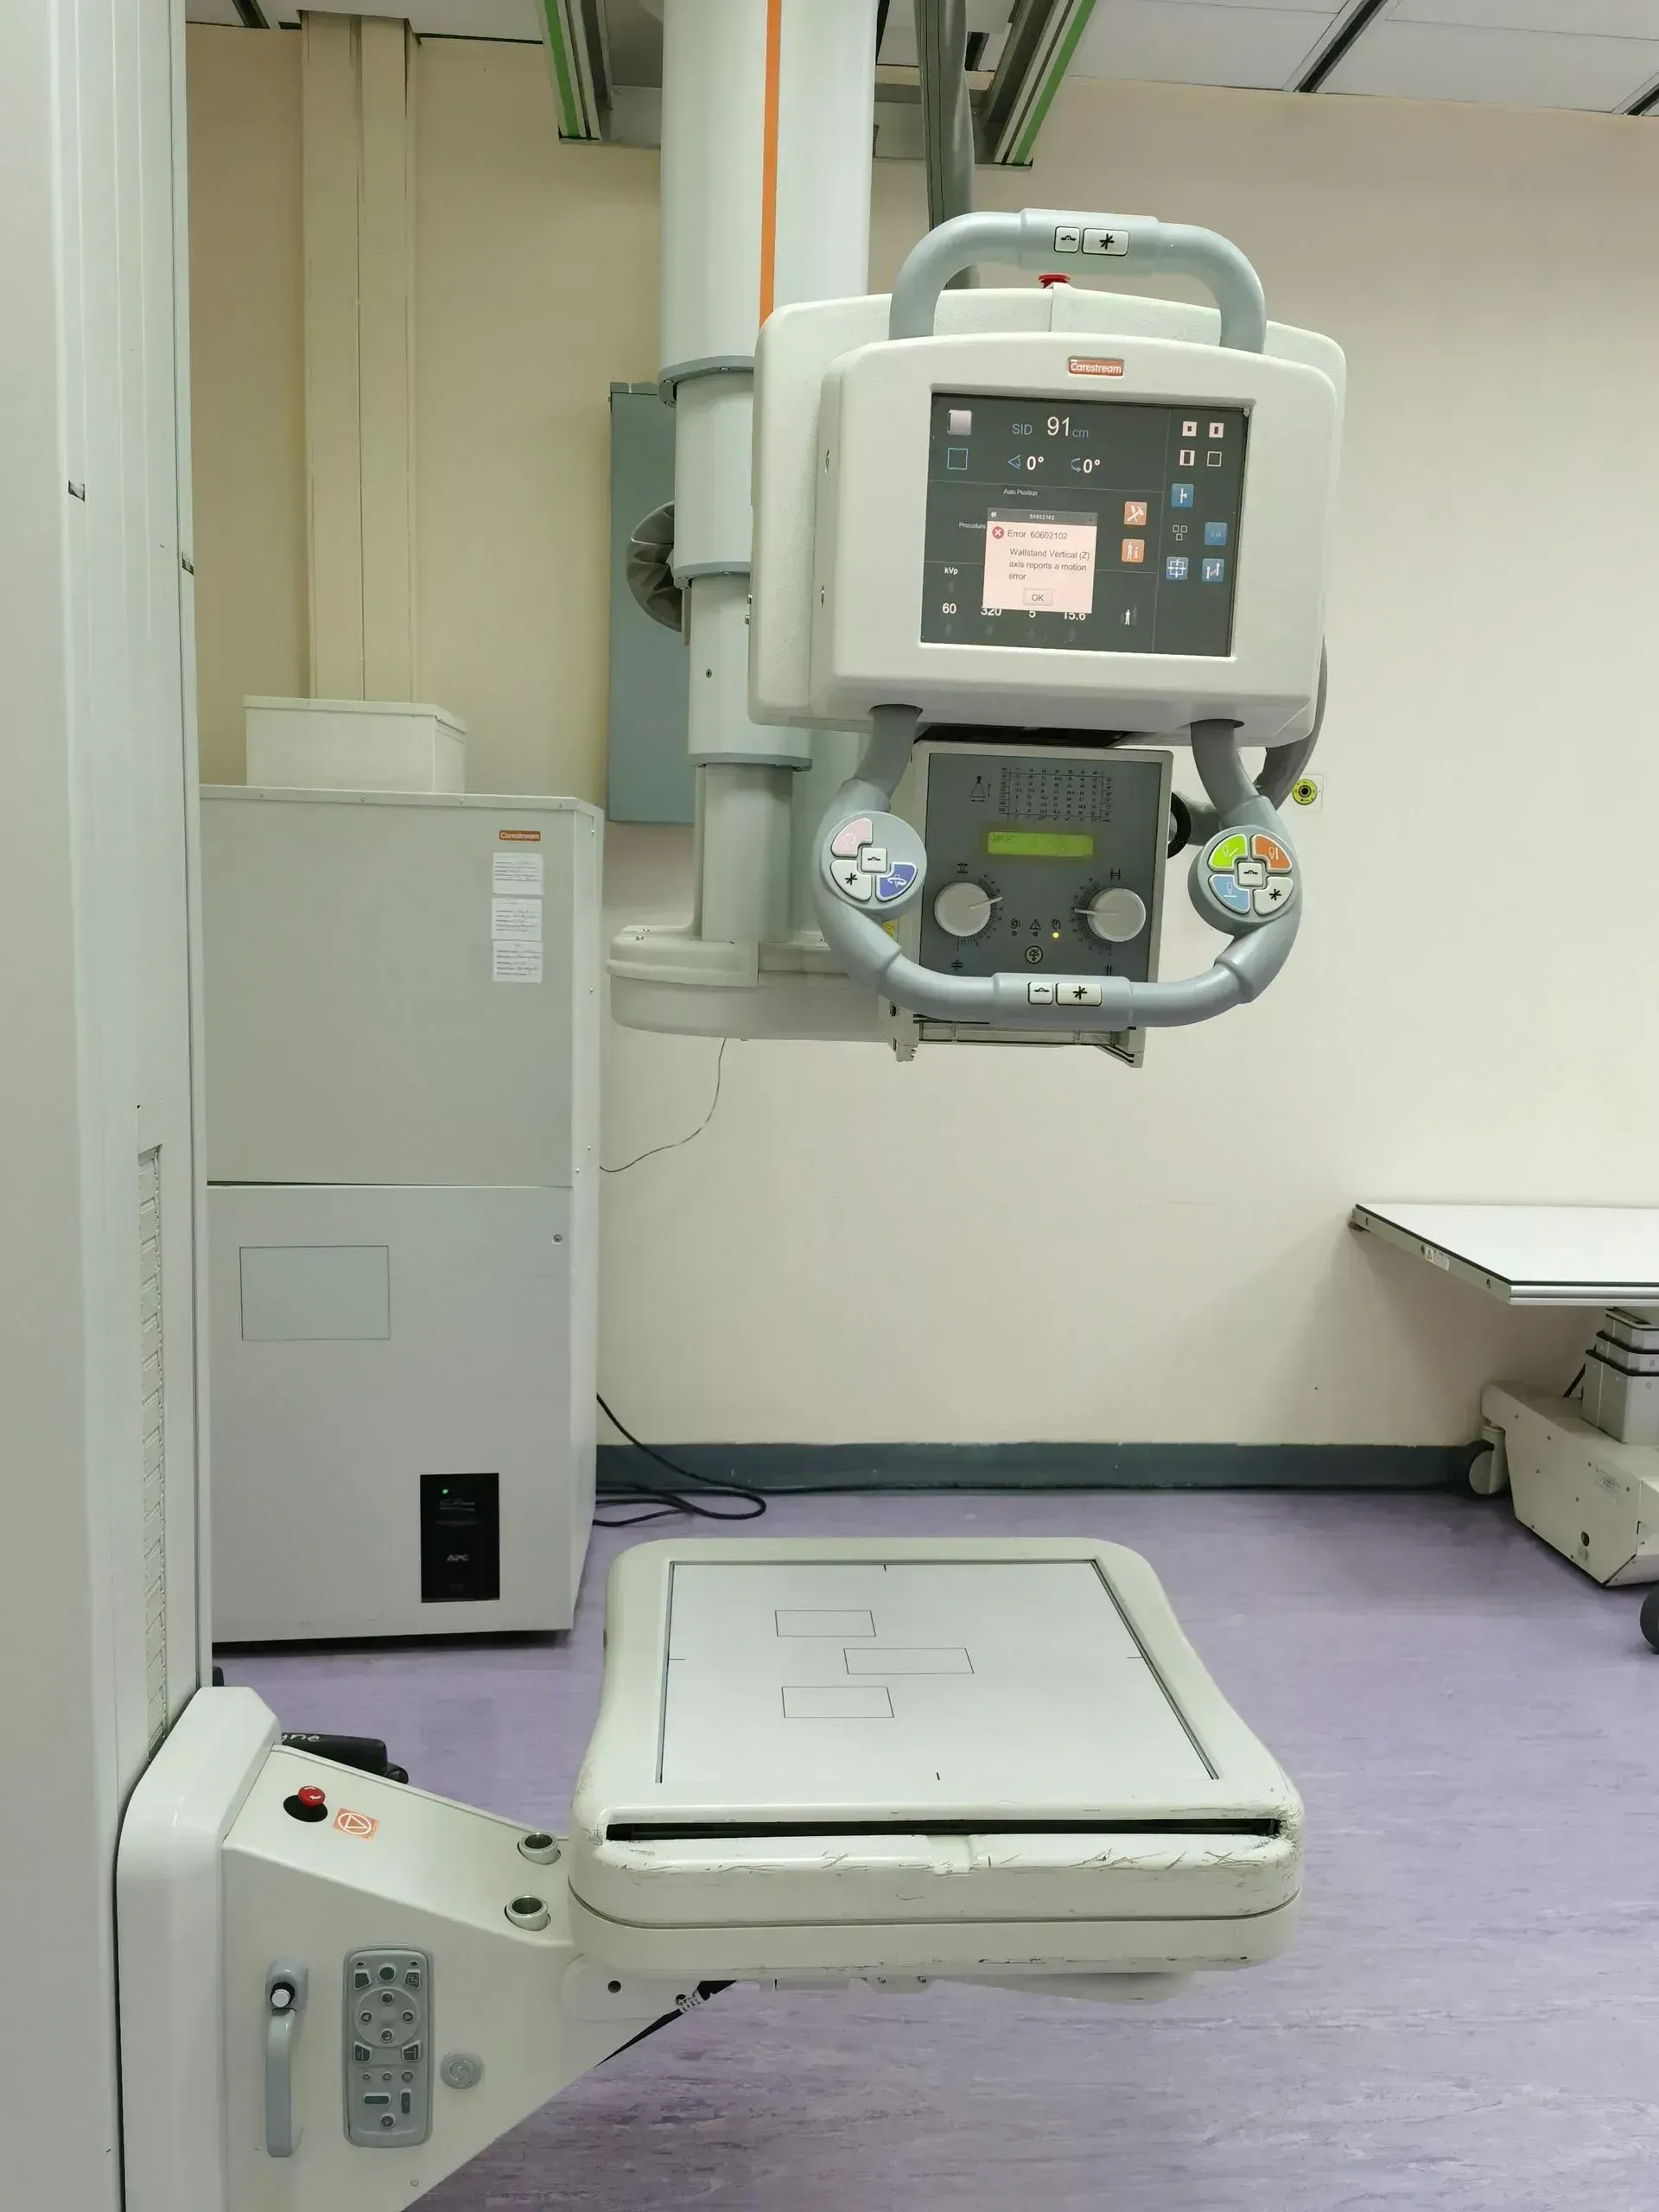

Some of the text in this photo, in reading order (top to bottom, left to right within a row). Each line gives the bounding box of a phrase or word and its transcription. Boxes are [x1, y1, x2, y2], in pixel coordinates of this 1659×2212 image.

[1071, 362, 1122, 374] Carestream
[1012, 416, 1090, 438] SID 91 cm
[1007, 530, 1068, 540] Error 60602102
[1010, 548, 1090, 561] Wallstand Vertical (Z)
[944, 567, 958, 575] kVp
[1026, 562, 1052, 570] reports
[942, 602, 957, 614] 60
